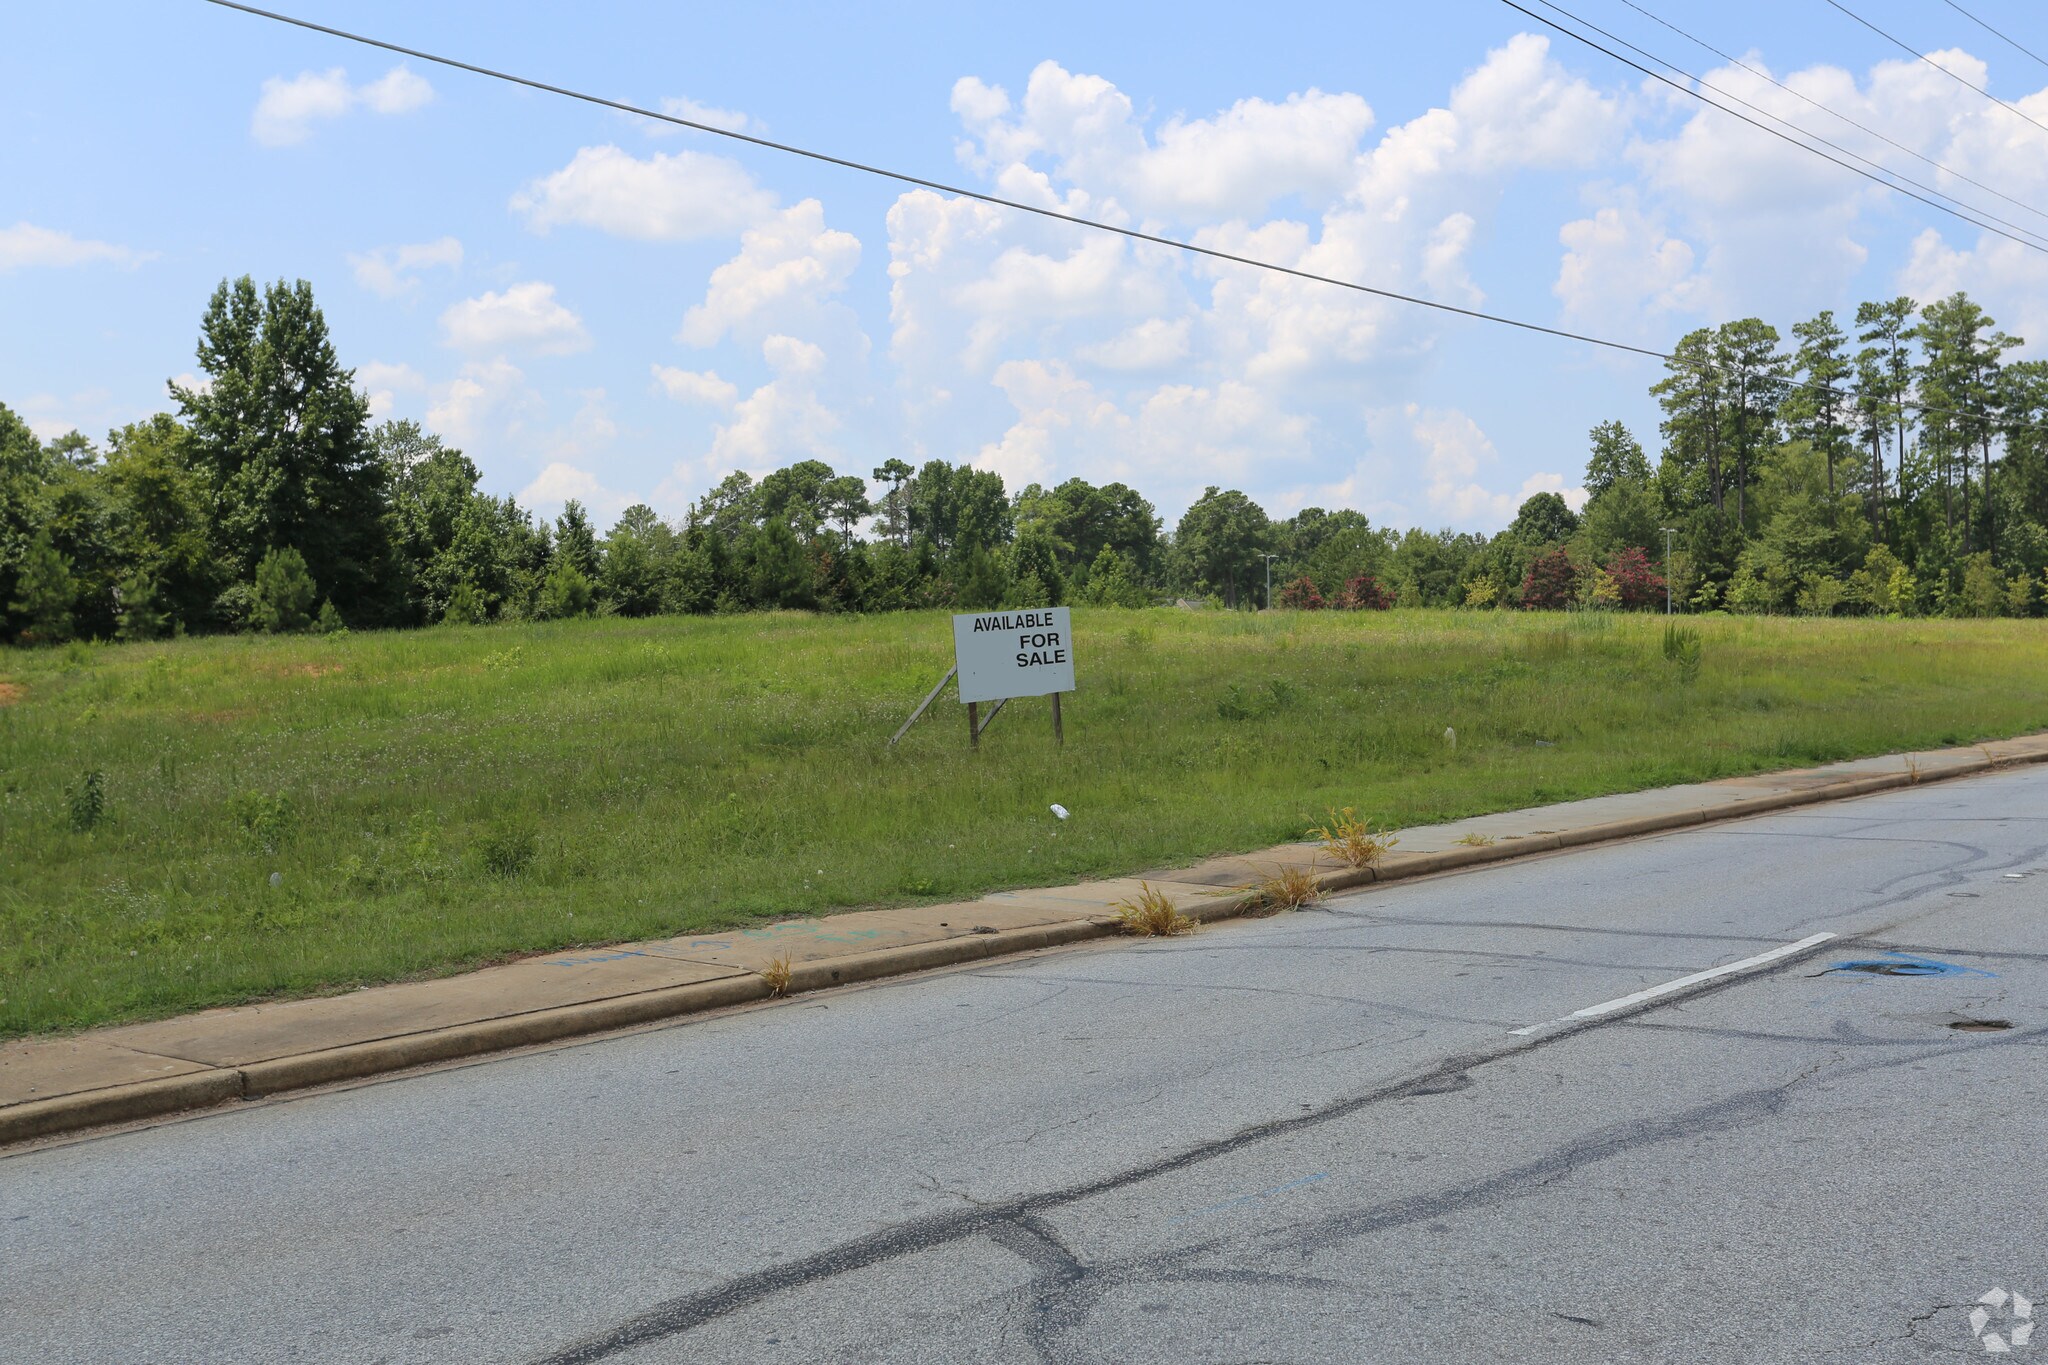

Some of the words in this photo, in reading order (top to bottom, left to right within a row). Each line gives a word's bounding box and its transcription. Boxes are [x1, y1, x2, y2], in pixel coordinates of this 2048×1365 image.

[974, 612, 1053, 632] AVAILABLE
[1020, 632, 1060, 649] FOR
[1016, 649, 1066, 667] SALE
